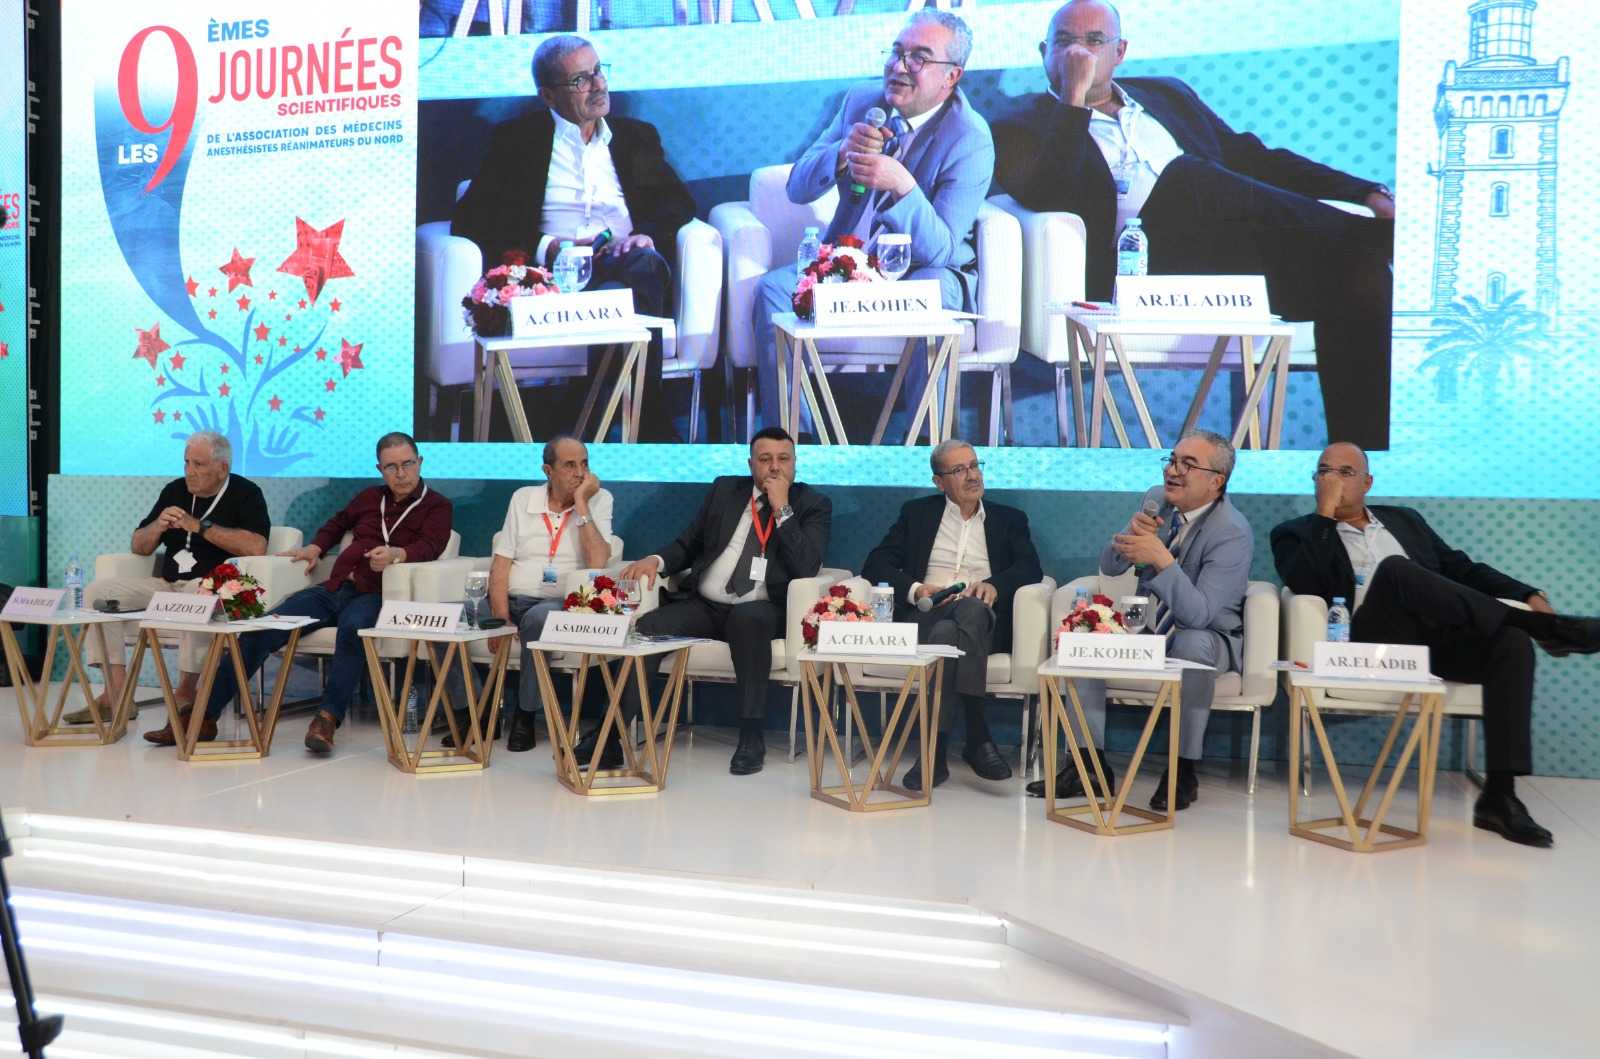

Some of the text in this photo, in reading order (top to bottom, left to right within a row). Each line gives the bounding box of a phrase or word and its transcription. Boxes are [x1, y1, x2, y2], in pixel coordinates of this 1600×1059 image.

[208, 18, 270, 42] ÈMES
[208, 27, 402, 103] JOURNÉES
[117, 25, 199, 195] LES 9
[277, 93, 402, 116] SCIENTIFIQUES
[206, 120, 402, 143] DE L'ASSOCIATION DES MÉDECINS
[206, 134, 404, 157] ANESTHÉSISTES RÉANIMATEURS DU NORD
[829, 298, 928, 314] JE.KOHEN
[526, 307, 622, 326] A.CHAARA
[153, 603, 207, 614] A.AZZOUZI
[387, 614, 448, 628] A.SBIHI
[552, 623, 618, 635] A.SADRAOUI
[827, 634, 907, 646] A.CHAARA
[1069, 646, 1154, 660] JE.KOHEN
